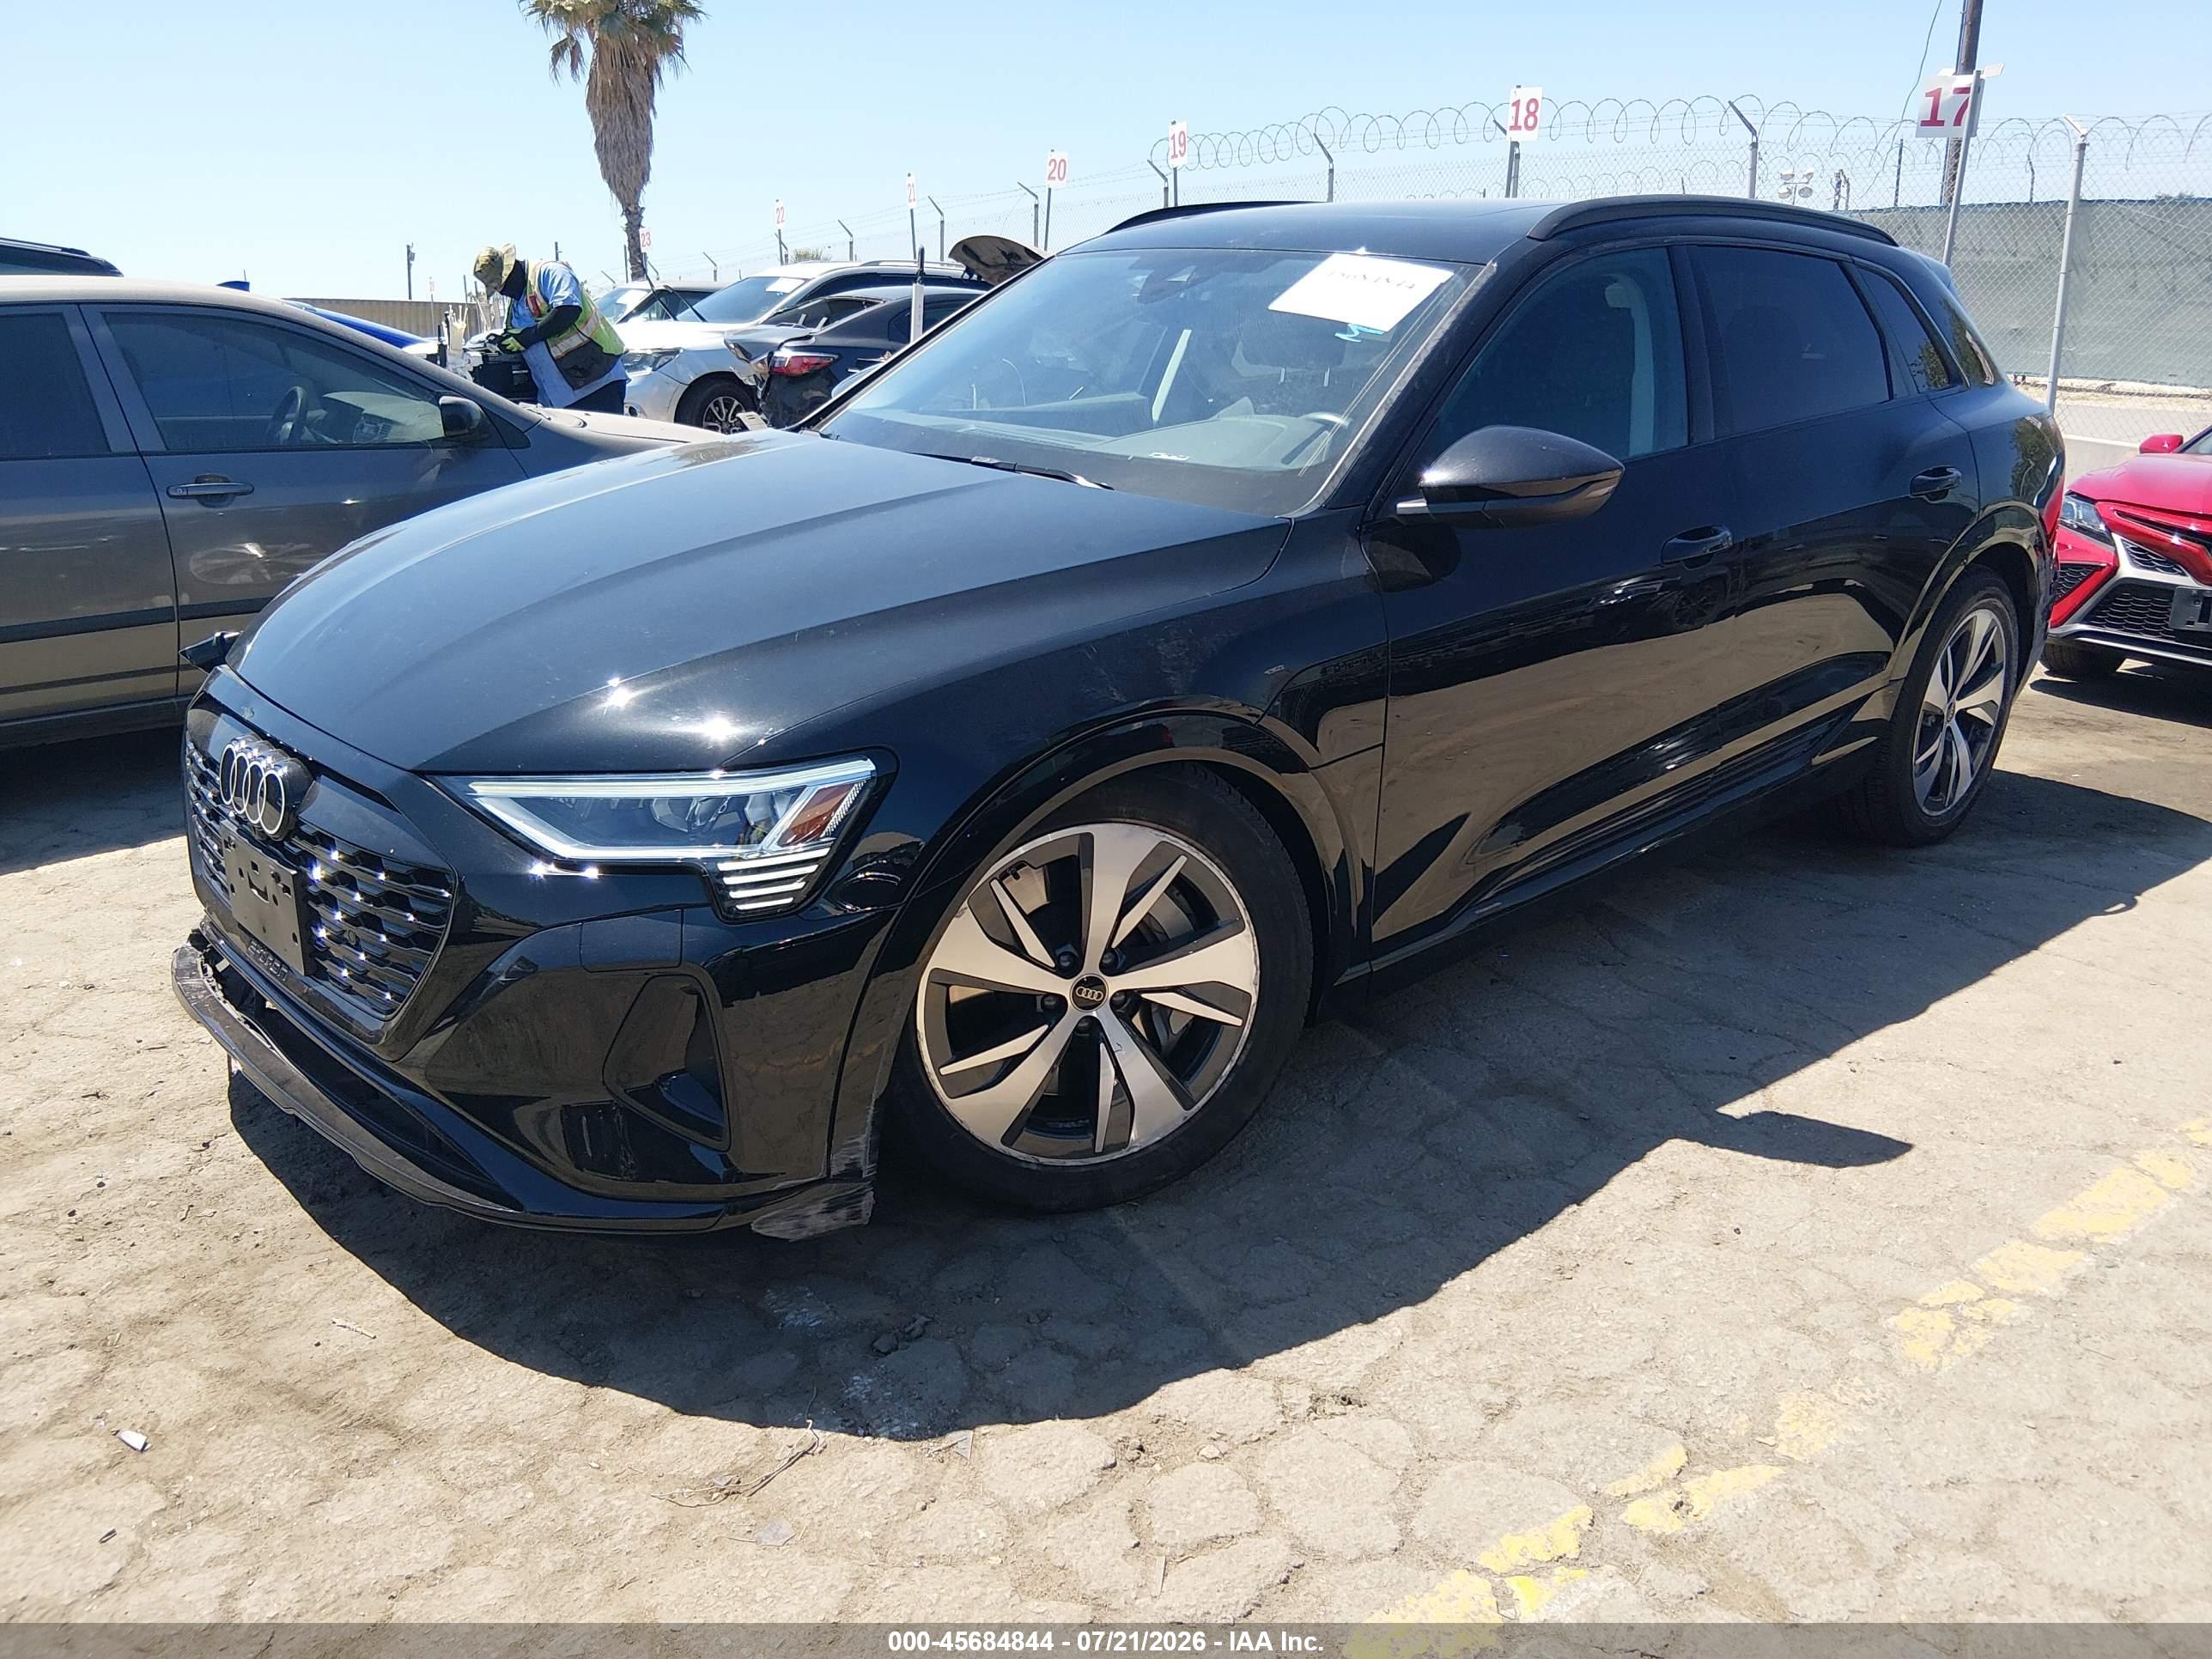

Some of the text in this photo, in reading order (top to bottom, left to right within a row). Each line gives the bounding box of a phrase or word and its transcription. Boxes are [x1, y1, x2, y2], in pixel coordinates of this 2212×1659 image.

[1509, 97, 1540, 131] 18
[1920, 87, 1972, 127] 17
[1170, 130, 1187, 159] 19
[1047, 158, 1067, 182] 20
[907, 182, 916, 204] 21
[775, 206, 785, 225] 22
[641, 231, 652, 248] 23
